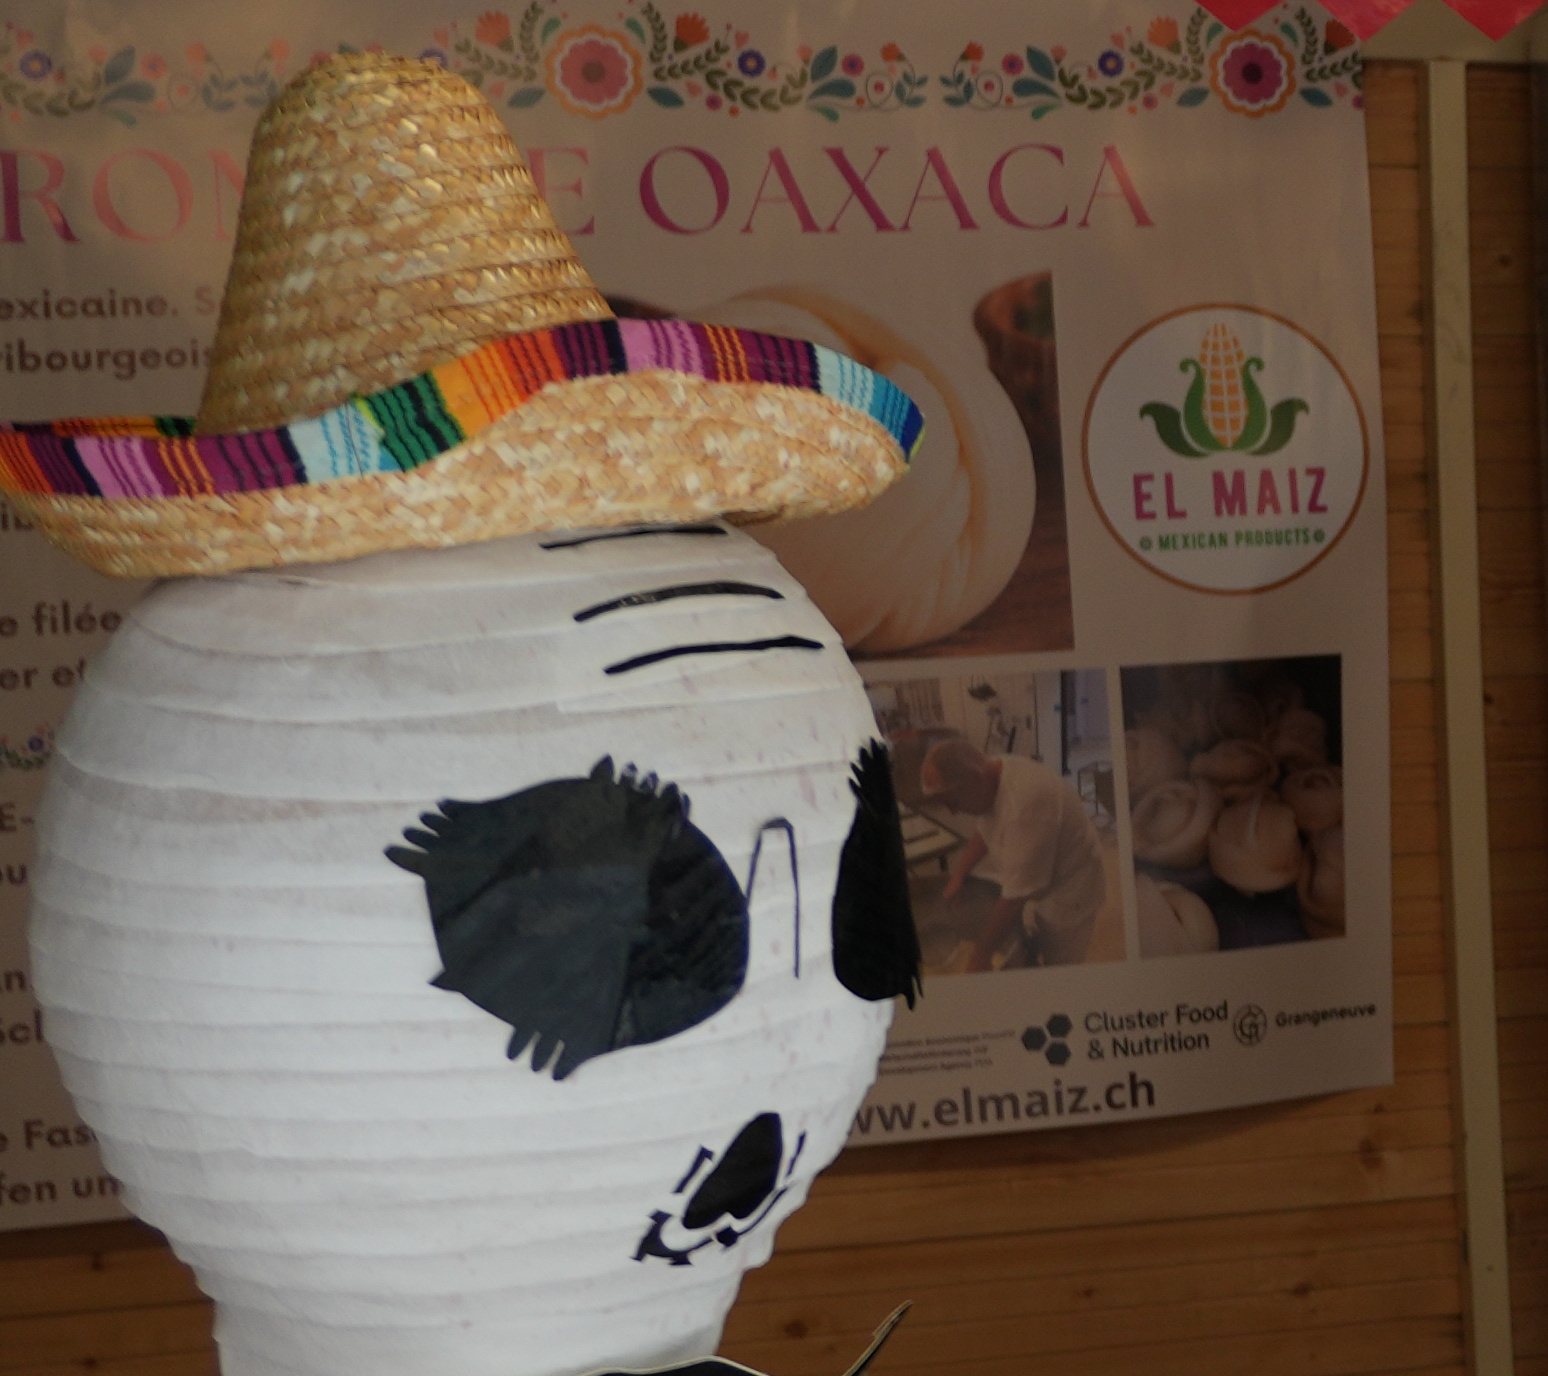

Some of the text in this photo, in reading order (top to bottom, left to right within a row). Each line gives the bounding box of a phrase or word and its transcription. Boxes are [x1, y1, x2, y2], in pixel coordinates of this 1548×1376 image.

[638, 143, 1156, 237] OAXACA
[1132, 465, 1329, 523] EL MAIZ
[1157, 526, 1312, 553] MEXICAN PRODUCTS
[1083, 1000, 1229, 1034] Cluster Food
[1275, 1002, 1377, 1029] Grangeneuve
[1087, 1029, 1211, 1061] & Nutrition
